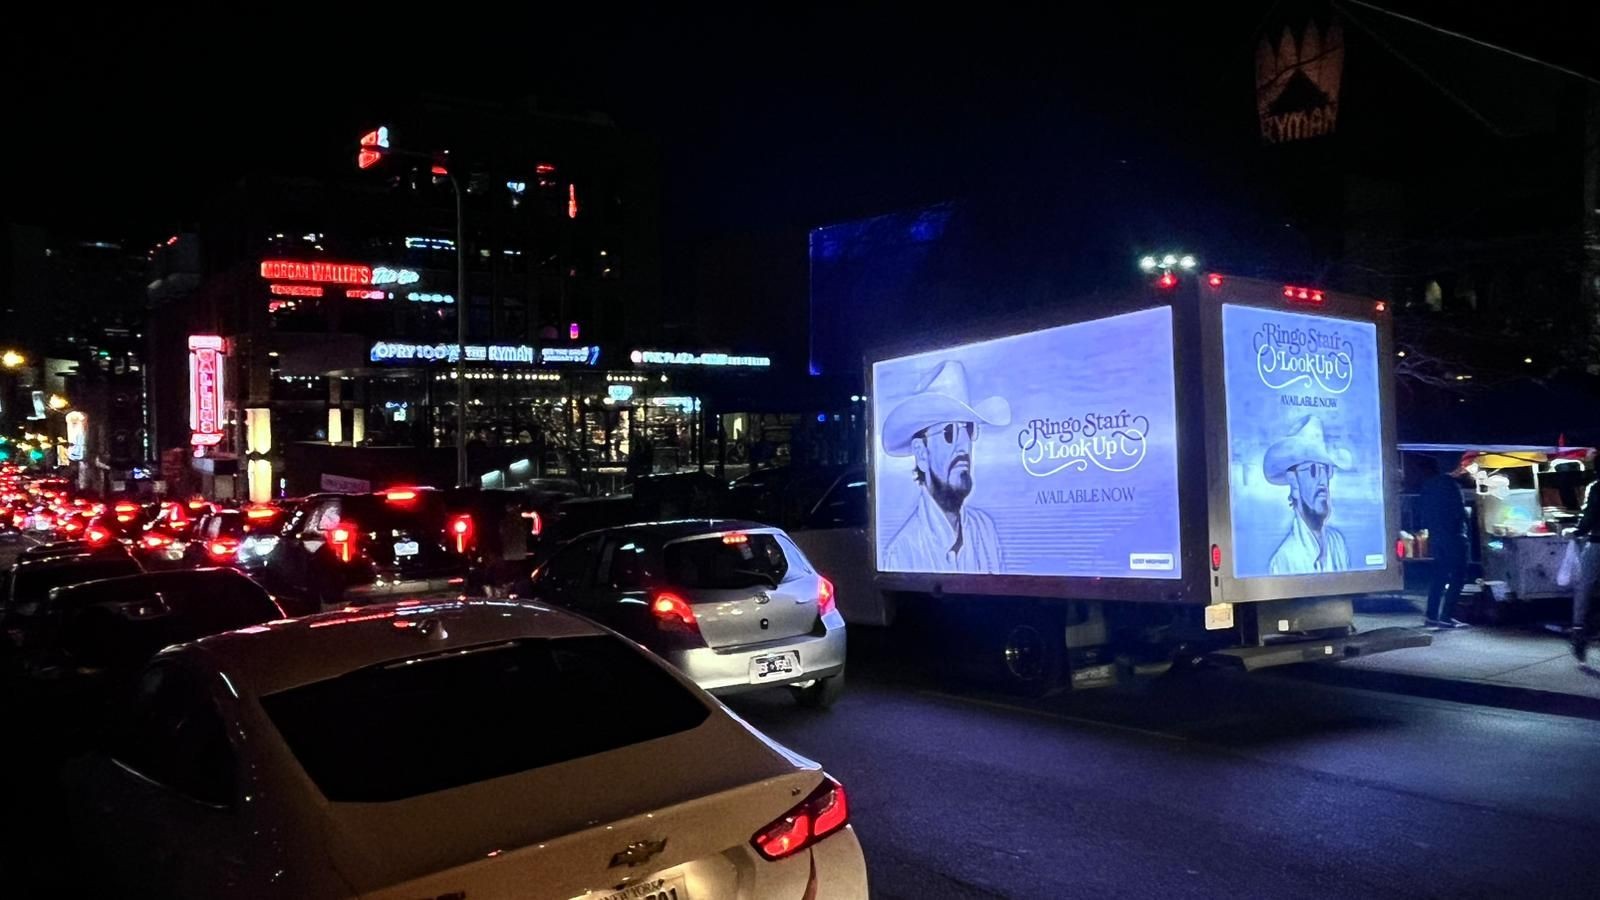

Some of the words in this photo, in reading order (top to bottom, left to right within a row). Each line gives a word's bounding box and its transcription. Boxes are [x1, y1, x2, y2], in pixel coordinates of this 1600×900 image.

[261, 262, 309, 280] MORGAN
[311, 263, 370, 284] WALLEN'S
[1253, 322, 1306, 356] Ringo
[376, 344, 416, 358] OPRY
[488, 345, 533, 361] RYMAN
[1315, 352, 1334, 380] Up
[1280, 394, 1319, 407] AVAILABLE
[1319, 396, 1338, 408] NOW
[1018, 416, 1082, 450] Ringo
[1082, 409, 1149, 441] Starr
[1093, 436, 1118, 460] Up
[1035, 488, 1100, 504] AVAILABLE
[1101, 487, 1136, 502] NOW
